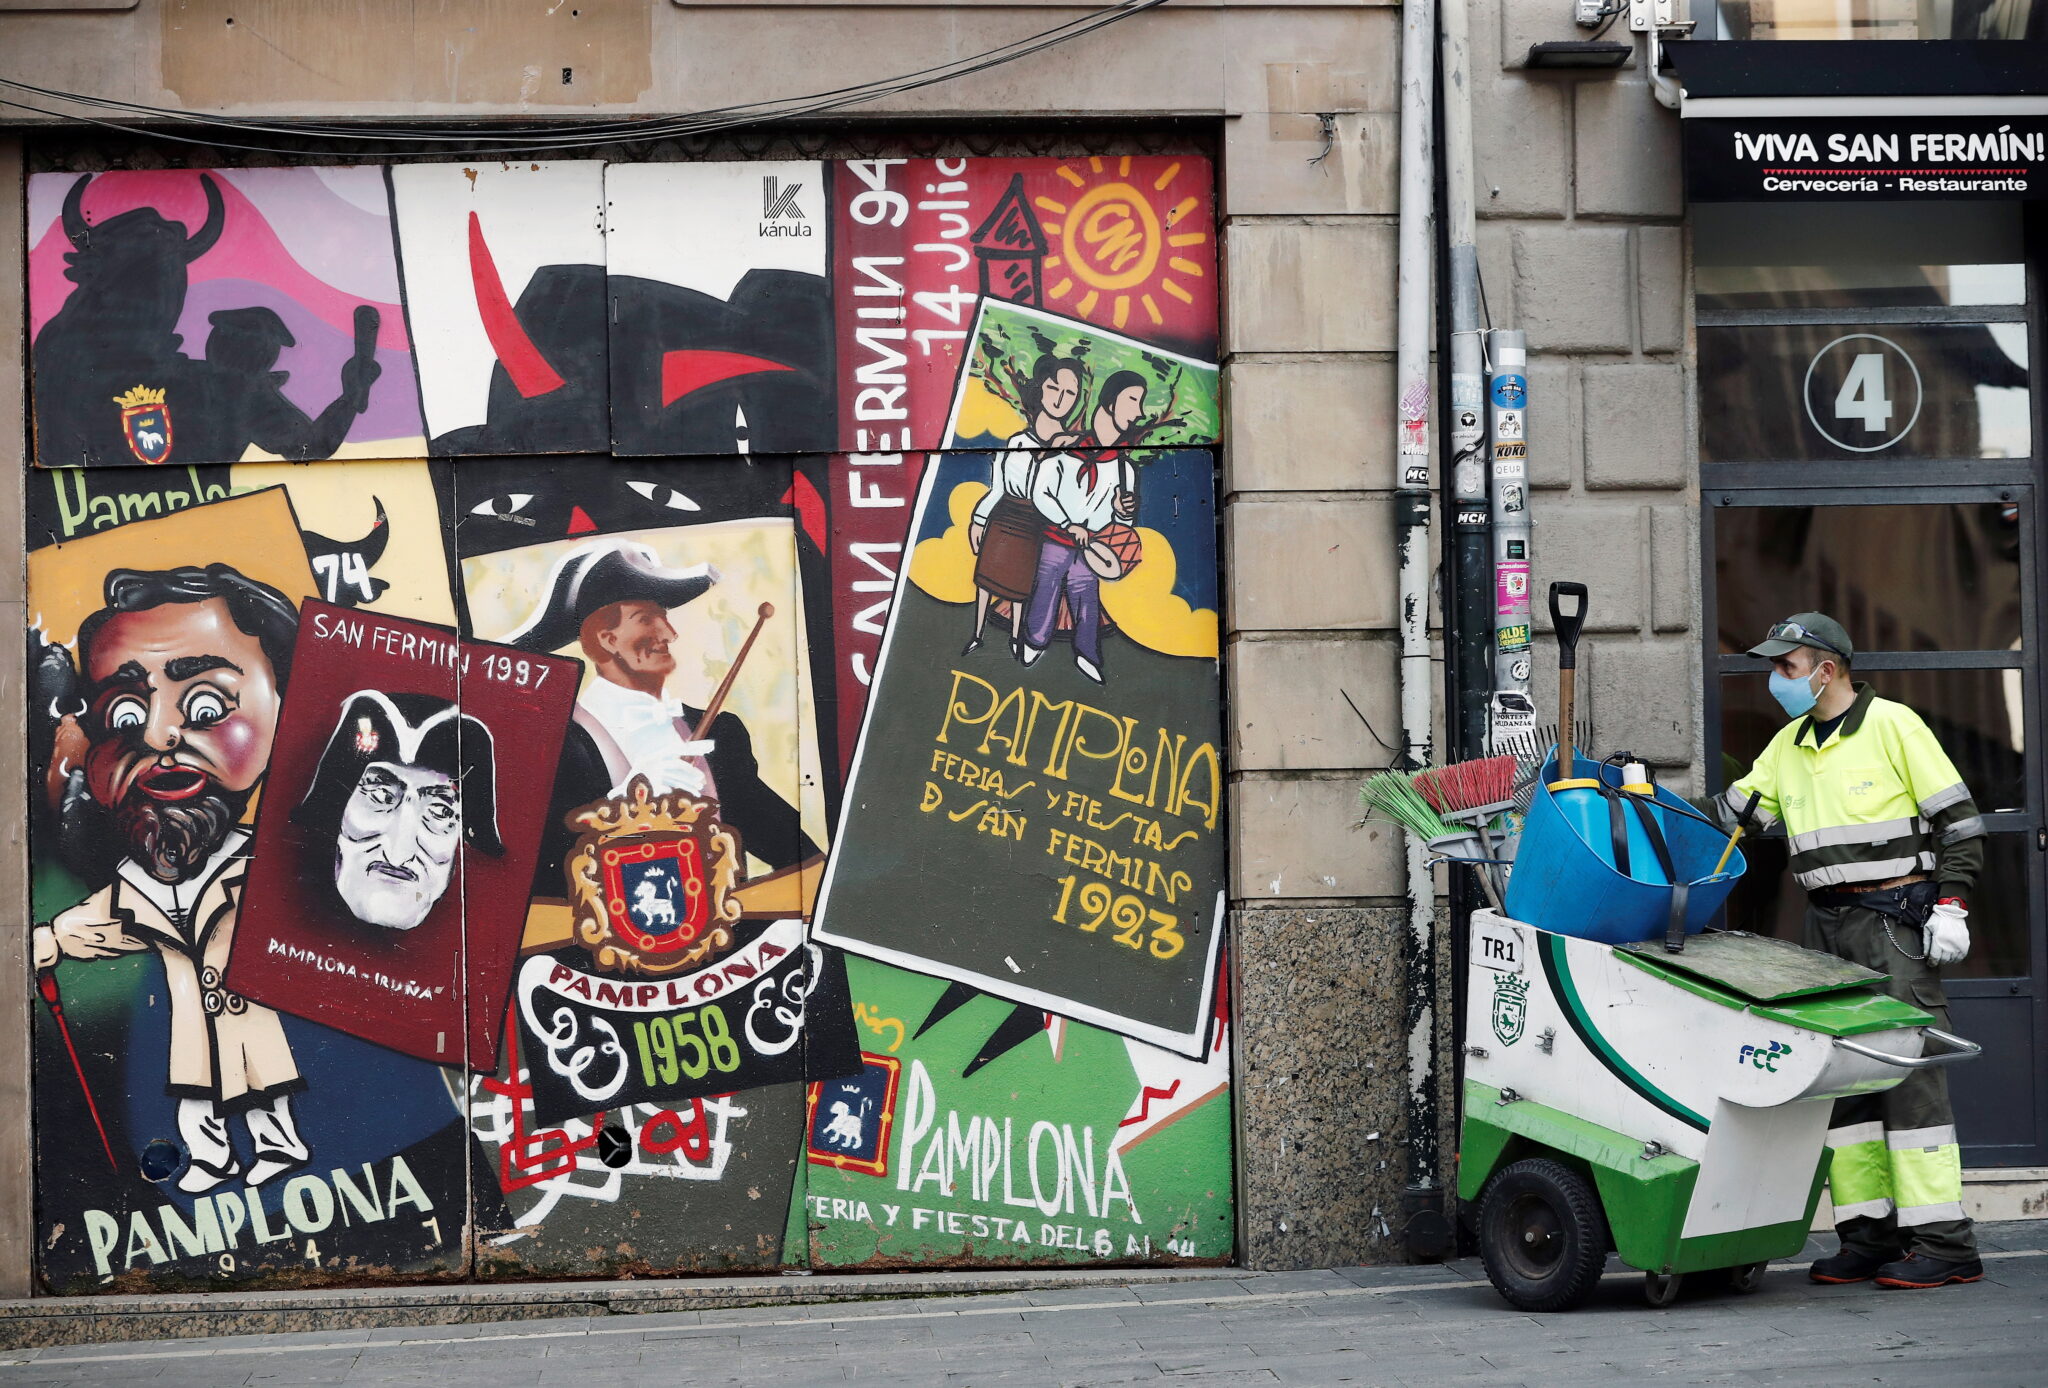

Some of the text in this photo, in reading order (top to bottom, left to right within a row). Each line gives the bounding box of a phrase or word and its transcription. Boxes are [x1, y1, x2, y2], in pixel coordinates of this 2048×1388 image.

[1827, 133, 1899, 162] SAN
[1910, 124, 2045, 162] FERMÍN!
[846, 158, 910, 228] 94
[1762, 177, 1878, 192] Cervecería
[1899, 177, 2028, 192] Restaurante
[759, 220, 812, 238] kánula
[911, 284, 979, 356] 14
[848, 256, 910, 509] FERMIN
[1834, 353, 1893, 432] 4
[1457, 513, 1487, 524] MCH
[312, 552, 375, 603] 74
[313, 613, 551, 690] SAN FERMIN 1997
[935, 669, 1220, 830] PAMPLONA
[1567, 702, 1575, 742] BELLOTA
[929, 749, 1036, 800] FERIAS
[1062, 790, 1200, 851] FIESTAS
[948, 800, 1028, 841] SAN
[1046, 828, 1193, 905] FERMIN
[1052, 874, 1186, 960] 1923
[1481, 936, 1516, 962] TR1
[549, 941, 787, 1008] PAMPLONA
[632, 1004, 741, 1087] 1958
[1738, 1044, 1781, 1073] FCC
[83, 1155, 434, 1277] PAMPLONA
[880, 1203, 901, 1227] Y
[912, 1207, 1031, 1245] FIESTA
